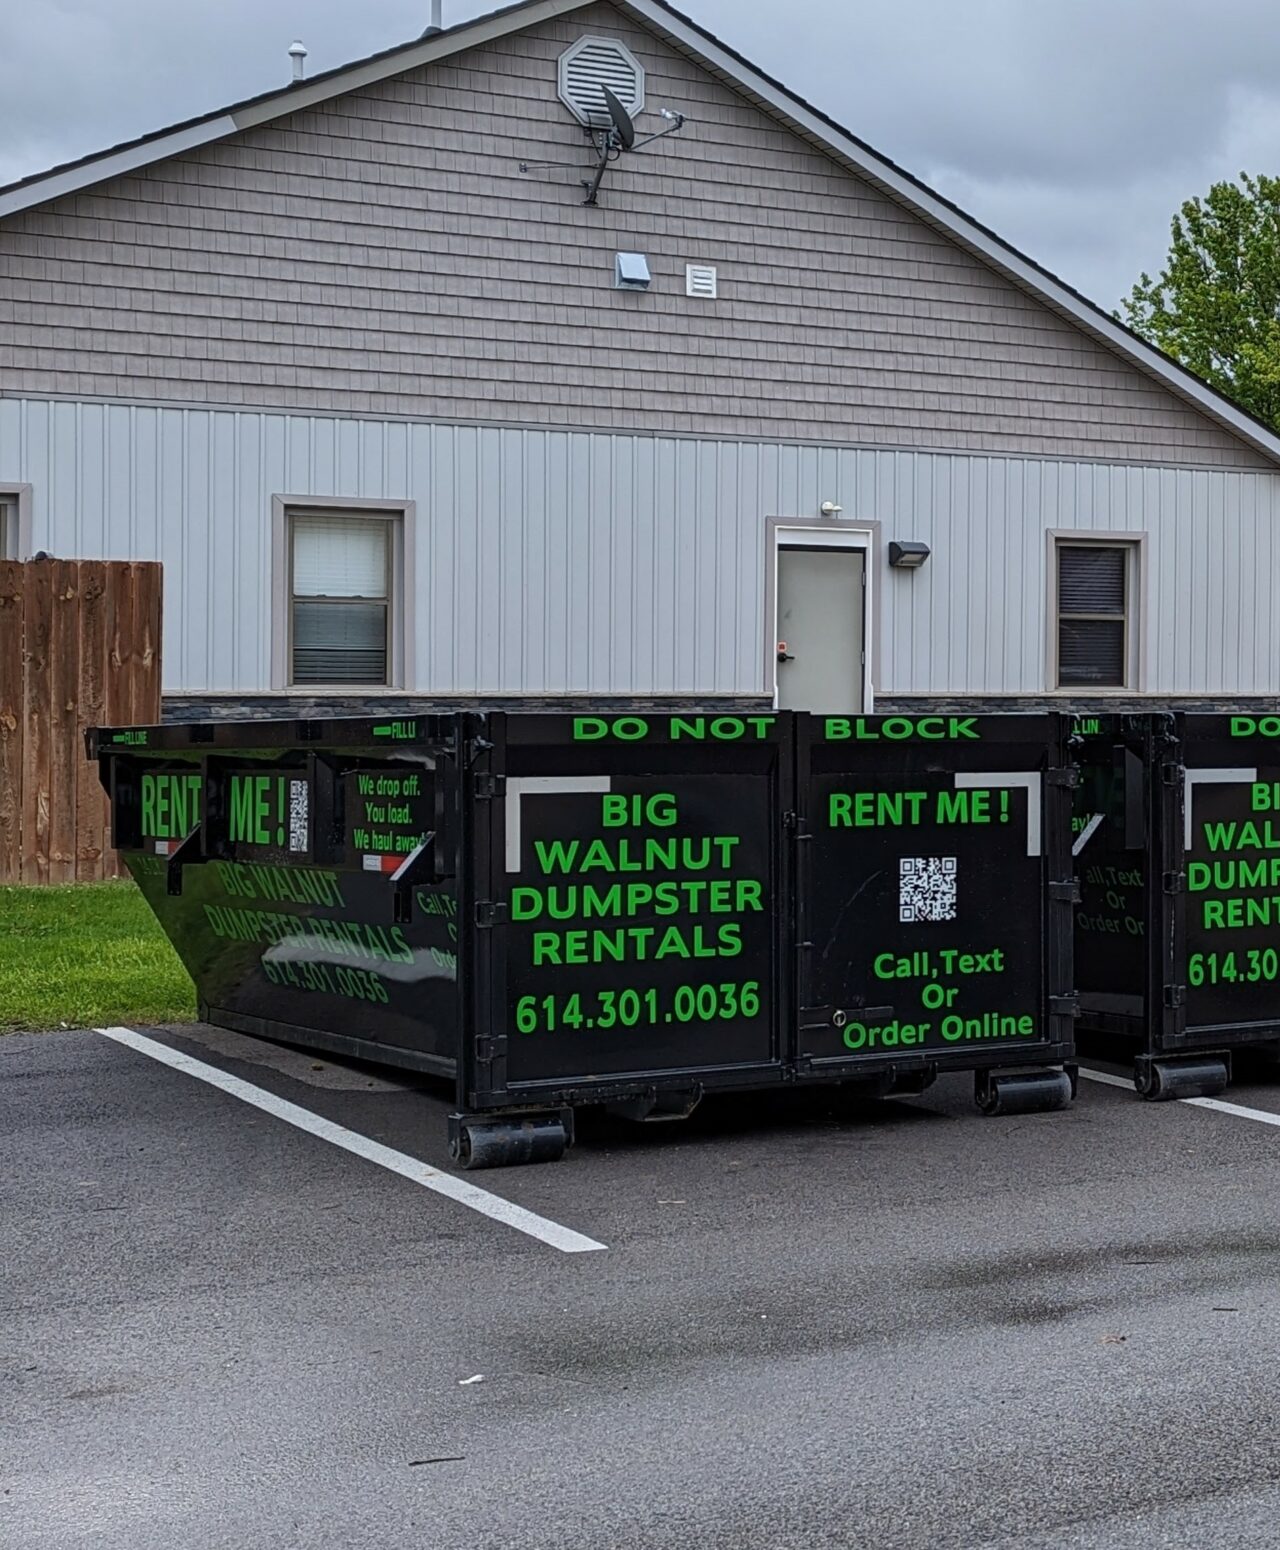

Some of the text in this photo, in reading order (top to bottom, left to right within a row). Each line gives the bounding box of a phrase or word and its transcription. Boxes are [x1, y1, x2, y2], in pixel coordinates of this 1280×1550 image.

[392, 722, 408, 738] FILL
[573, 717, 976, 741] DO NOT BLOCK
[1082, 719, 1099, 734] LIN
[358, 773, 421, 798] We drop off.
[141, 774, 202, 839] RENT
[365, 801, 413, 824] You load.
[603, 793, 677, 827] BIG
[829, 792, 927, 827] RENT
[353, 828, 370, 850] We
[372, 829, 393, 852] haul
[535, 836, 740, 874] WALNUT
[216, 863, 347, 908] BIG WALNUT
[512, 880, 762, 920] DUMPSTER
[203, 903, 307, 949] DUMPSTER
[308, 917, 416, 965] RENTALS
[533, 923, 742, 965] RENTALS
[874, 949, 1003, 980] Call,Text
[516, 981, 760, 1033] 614.301.0036
[921, 983, 958, 1009] Or
[843, 1013, 1033, 1049] Order Online
